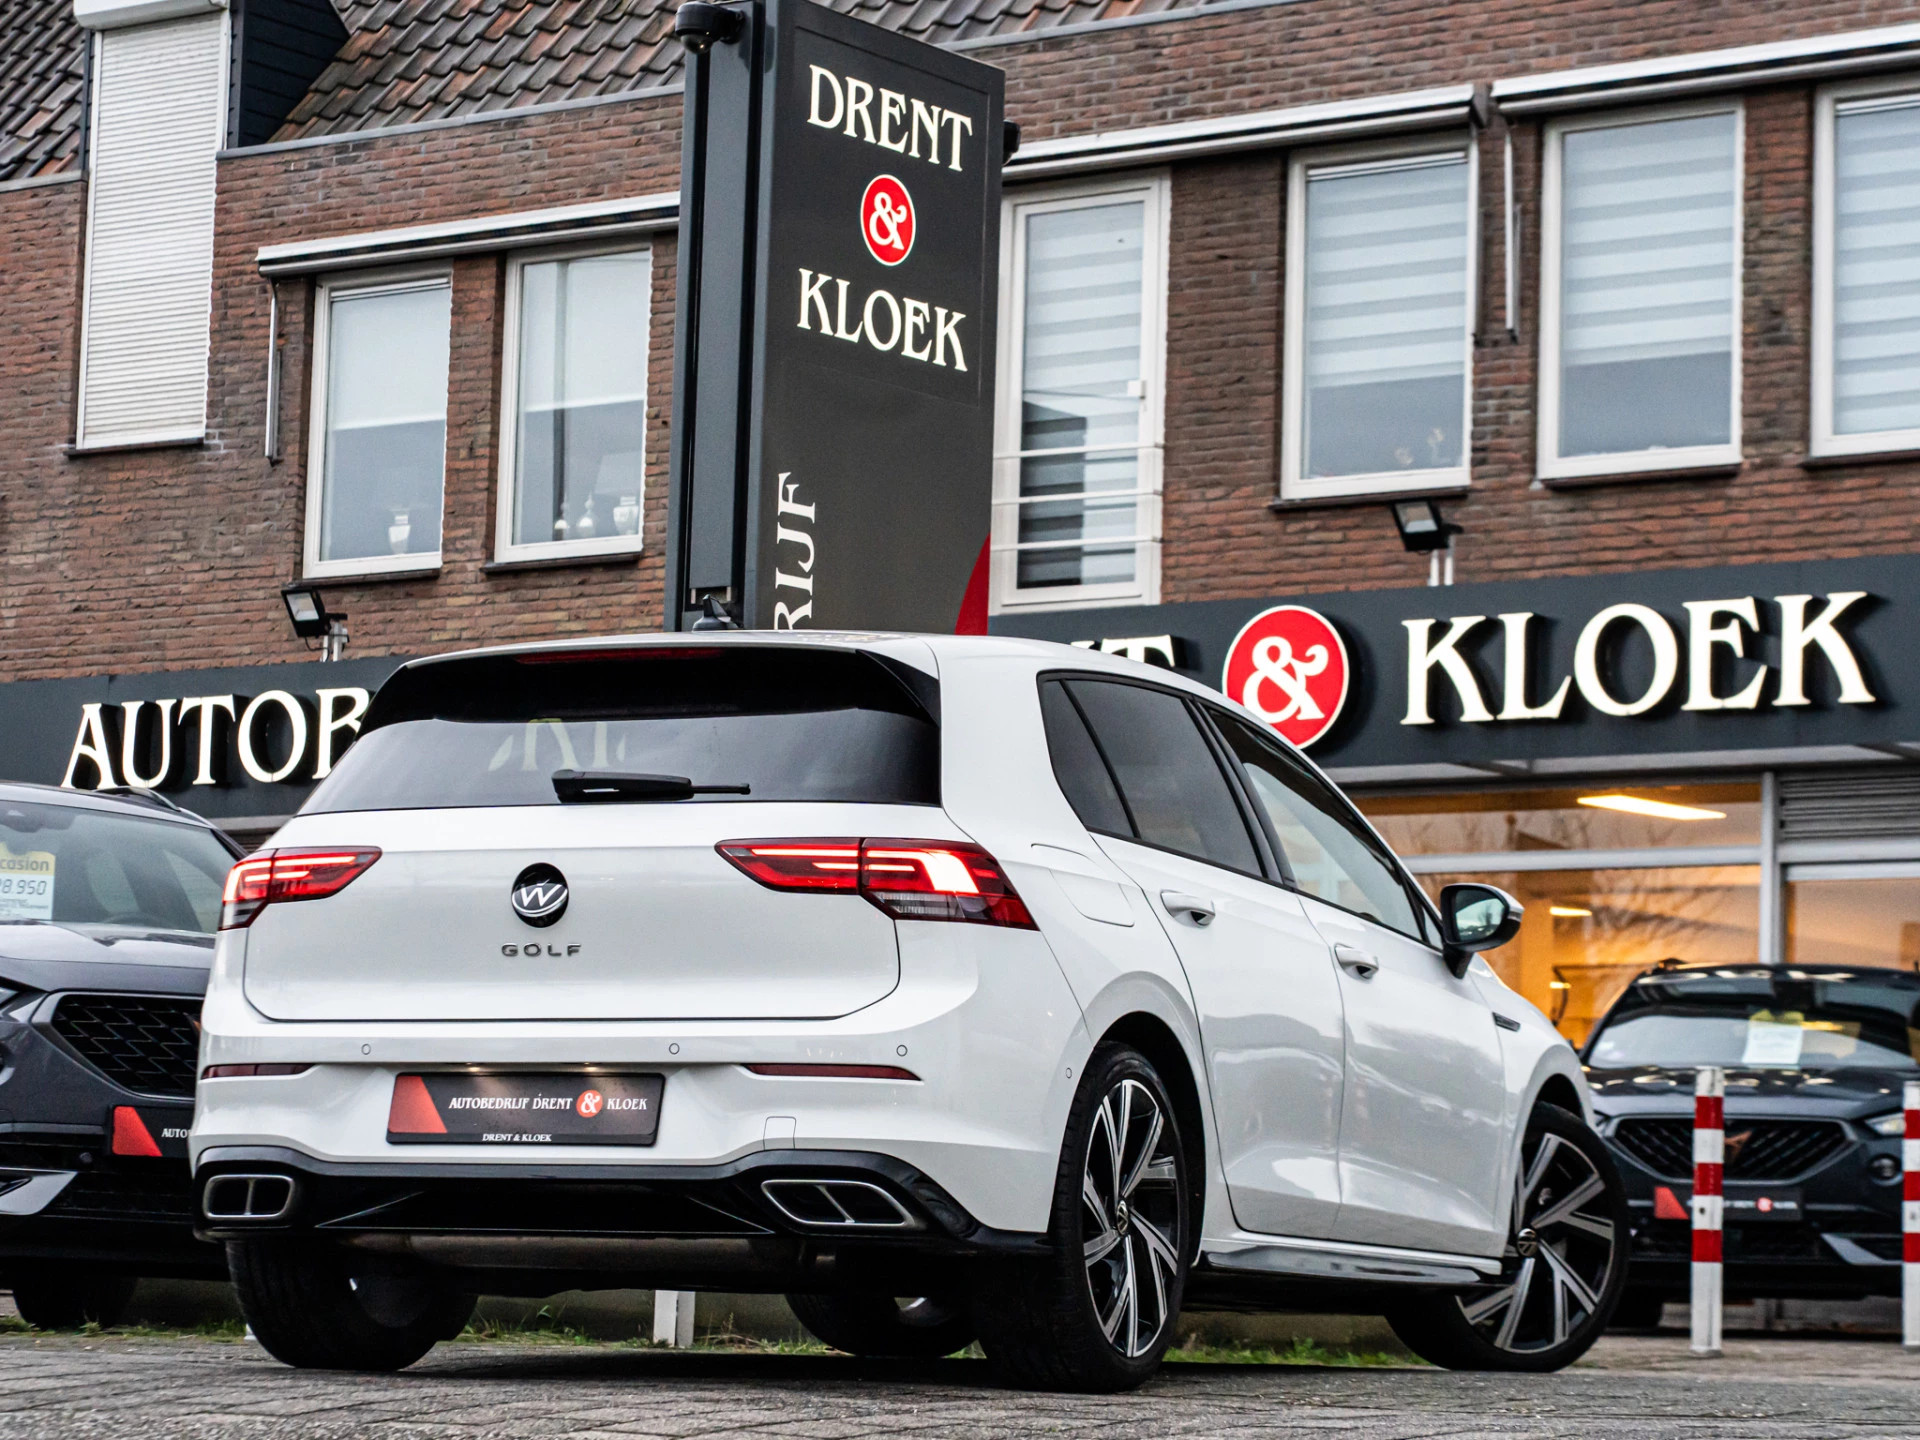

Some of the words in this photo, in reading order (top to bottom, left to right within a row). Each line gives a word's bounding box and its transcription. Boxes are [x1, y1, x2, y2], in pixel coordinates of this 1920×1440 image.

[807, 63, 974, 172] DRENT
[869, 191, 907, 251] &
[797, 267, 968, 373] KLOEK
[1243, 636, 1329, 724] &
[1400, 591, 1876, 725] KLOEK
[501, 943, 582, 957] GOLF
[448, 1097, 530, 1110] AUTOBEDRIJF
[532, 1097, 573, 1110] DRENT
[580, 1092, 600, 1114] &
[606, 1098, 647, 1110] KLOEK
[161, 1127, 191, 1138] AUTO
[482, 1133, 512, 1142] DRENT
[513, 1133, 521, 1142] &
[522, 1133, 552, 1142] KLOEK
